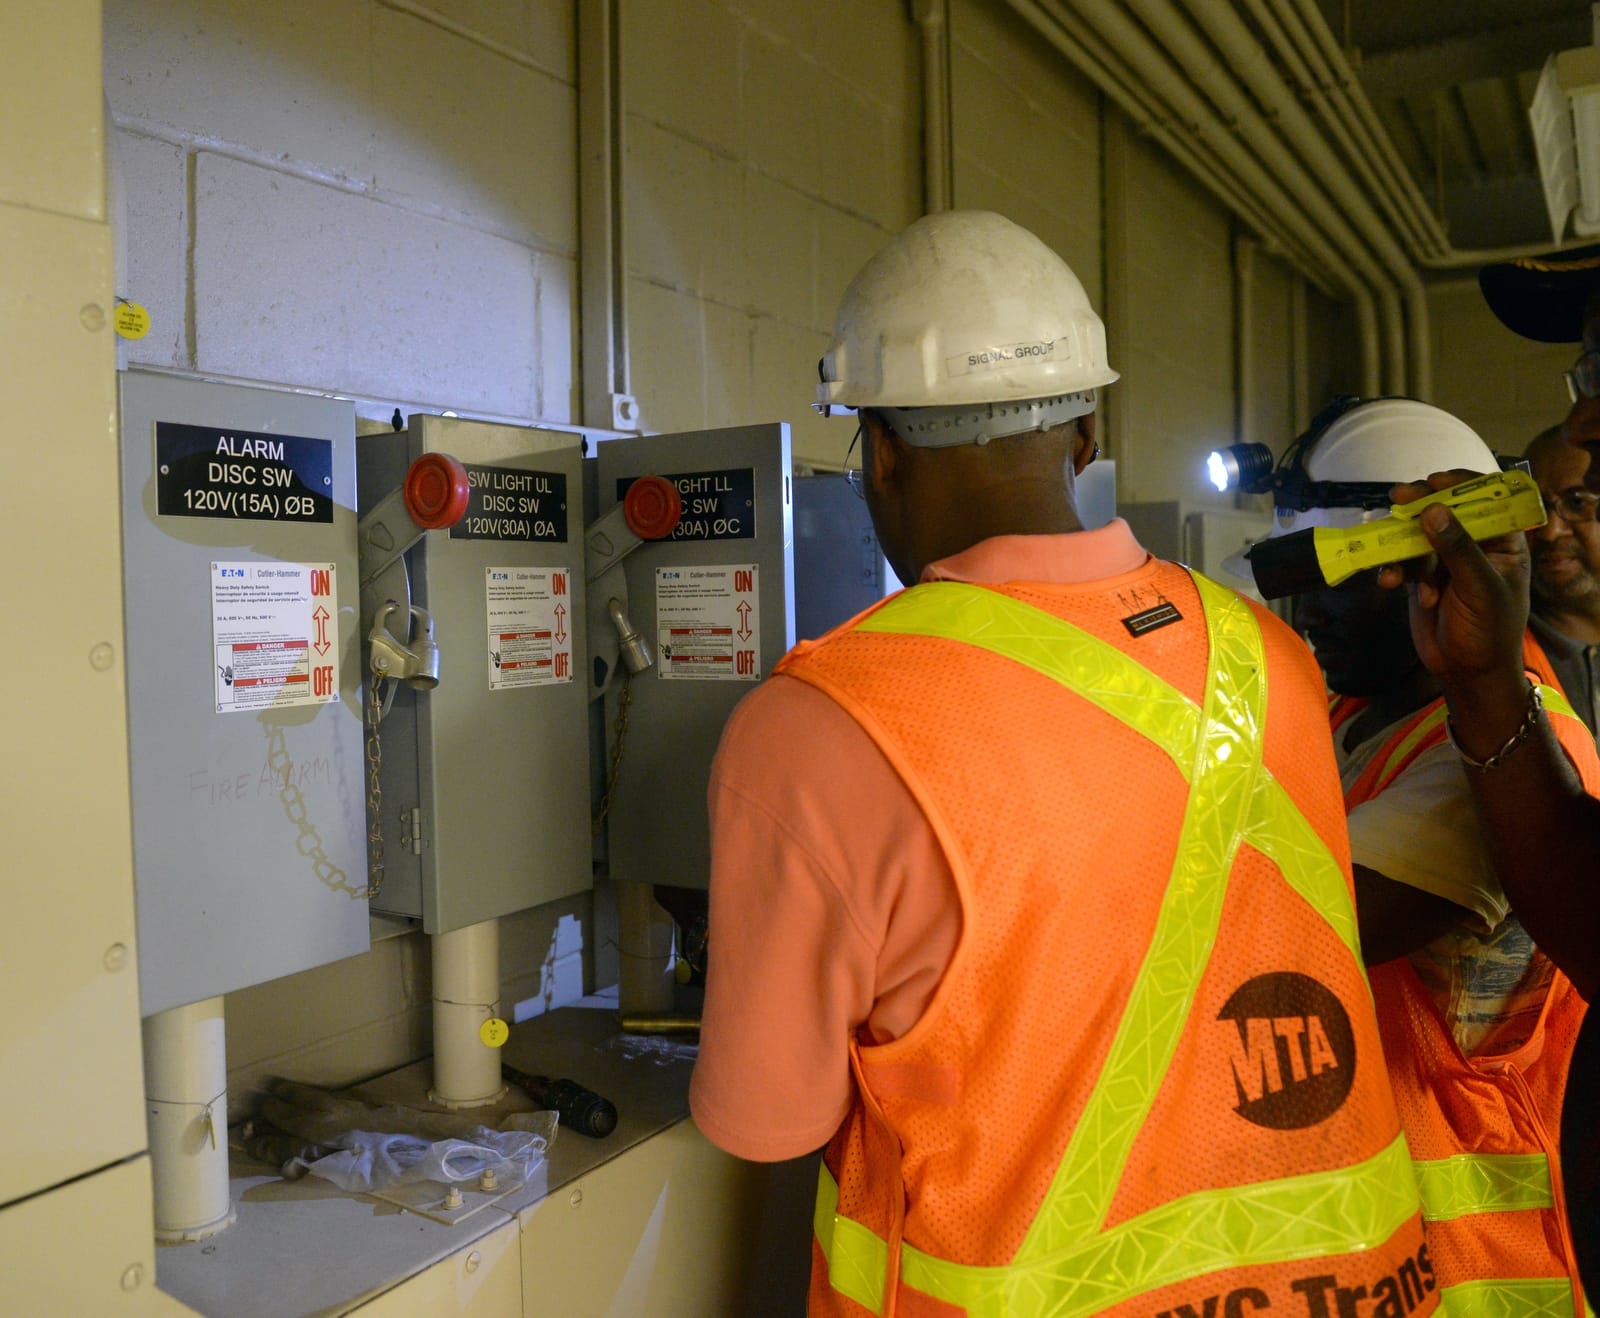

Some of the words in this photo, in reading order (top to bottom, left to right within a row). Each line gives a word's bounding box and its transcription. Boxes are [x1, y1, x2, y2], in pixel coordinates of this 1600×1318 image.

[968, 350, 1013, 366] SIGNAL
[1015, 344, 1055, 359] GROUP
[215, 436, 284, 461] ALARM
[208, 462, 256, 485] DISC
[262, 467, 293, 488] SW
[468, 471, 490, 489] SW
[494, 473, 533, 492] LIGHT
[535, 477, 552, 494] UL
[673, 477, 711, 494] IGHT
[715, 476, 733, 492] LL
[183, 488, 280, 519] 120V(15A)
[483, 495, 516, 513] DISC
[519, 497, 540, 514] SW
[692, 497, 718, 514] SW
[465, 517, 530, 540] 120V(30A)
[671, 520, 709, 540] (30A)
[310, 569, 331, 596] ON
[552, 573, 566, 596] ON
[734, 570, 753, 593] ON
[262, 642, 285, 650] DANGER
[555, 652, 569, 678] OFF
[736, 650, 755, 675] OFF
[313, 665, 334, 697] OFF
[187, 769, 251, 803] FIRE
[1216, 1015, 1339, 1104] MTA
